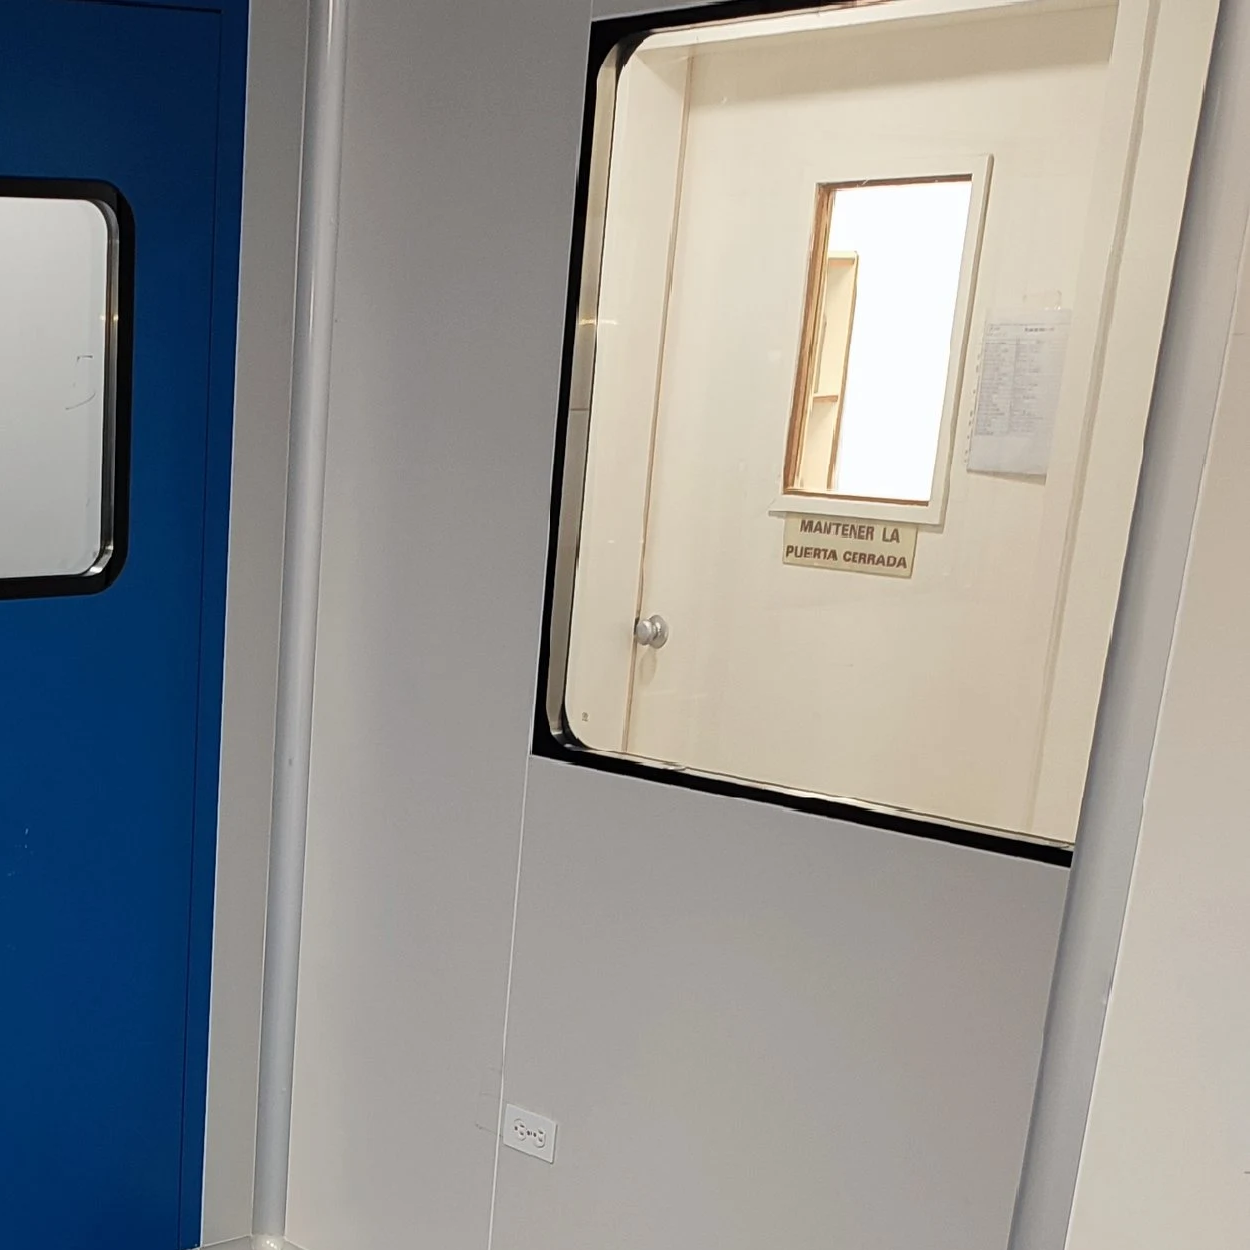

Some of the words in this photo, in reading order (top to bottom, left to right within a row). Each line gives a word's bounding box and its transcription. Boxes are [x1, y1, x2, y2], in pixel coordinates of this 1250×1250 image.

[800, 519, 875, 541] MANTENER
[882, 527, 900, 543] LA
[785, 544, 838, 561] PUERTA
[842, 550, 907, 568] CERRADA
